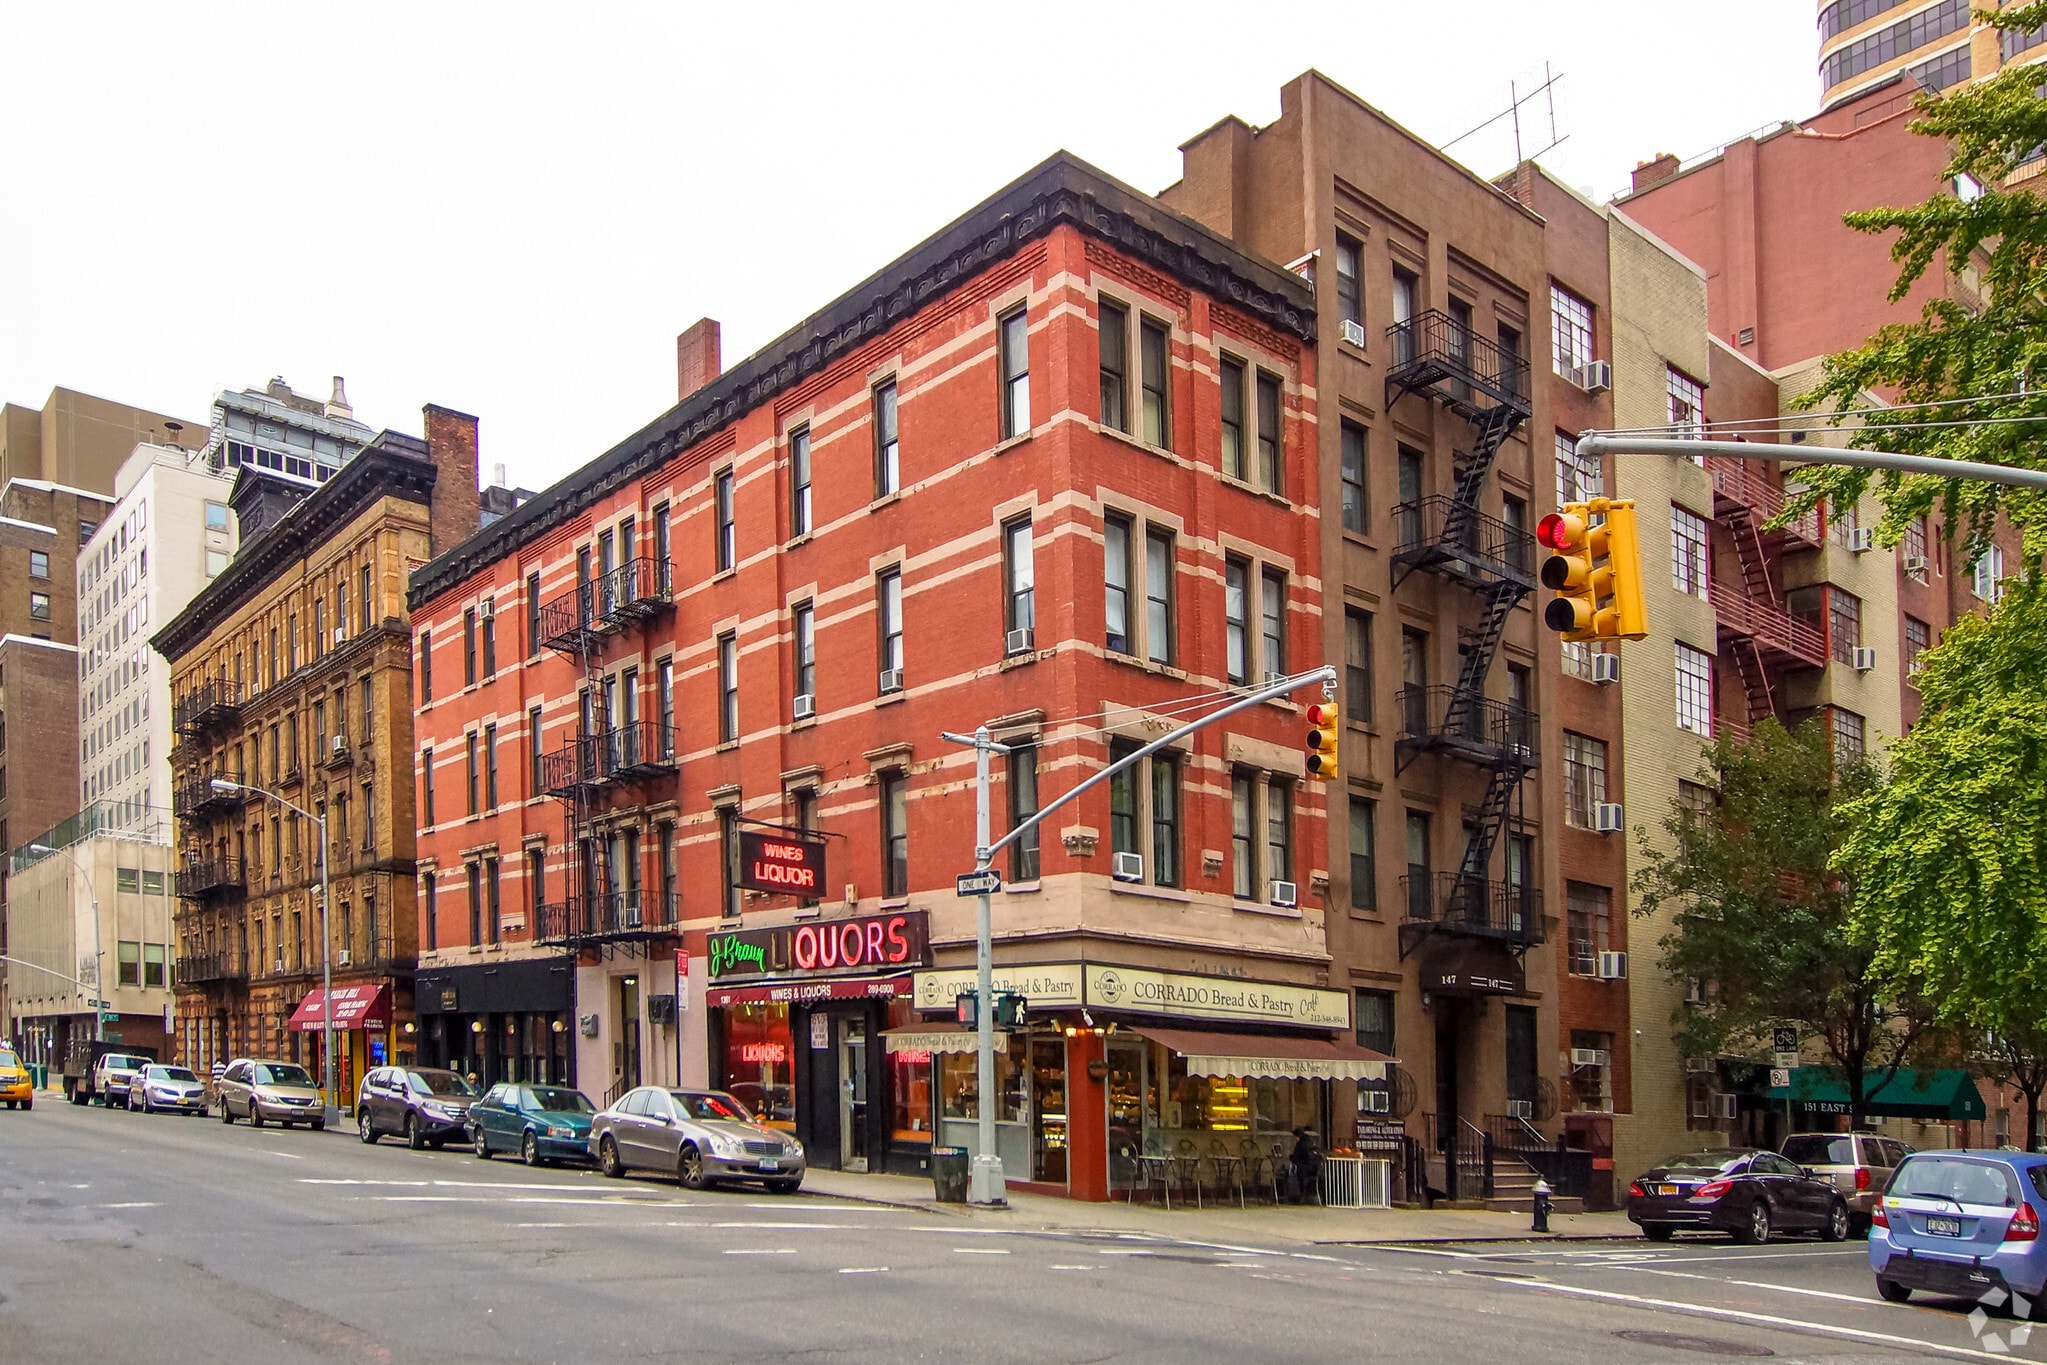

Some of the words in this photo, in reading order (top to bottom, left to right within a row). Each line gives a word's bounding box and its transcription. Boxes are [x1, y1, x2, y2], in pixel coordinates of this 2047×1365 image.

[764, 843, 804, 862] WINES
[755, 862, 814, 887] LIQUOR
[962, 879, 975, 890] ONE
[982, 878, 995, 887] WAY
[771, 917, 909, 970] LIQUORS
[1003, 979, 1030, 995] Bread
[1032, 978, 1042, 993] &
[1044, 977, 1075, 996] Pastry
[1094, 980, 1127, 993] CORRADO
[1441, 975, 1457, 985] 147
[1488, 979, 1499, 988] 147
[771, 988, 792, 1000] WINES
[793, 987, 799, 999] &
[800, 985, 831, 998] LIQUORS
[1134, 981, 1209, 1004] CORRADO
[1212, 989, 1244, 1008] Bread
[1248, 993, 1259, 1009] &
[1262, 994, 1294, 1015] Pastry
[742, 1043, 785, 1062] LIQUORS
[1804, 1102, 1817, 1112] 151
[1821, 1102, 1846, 1113] EAST
